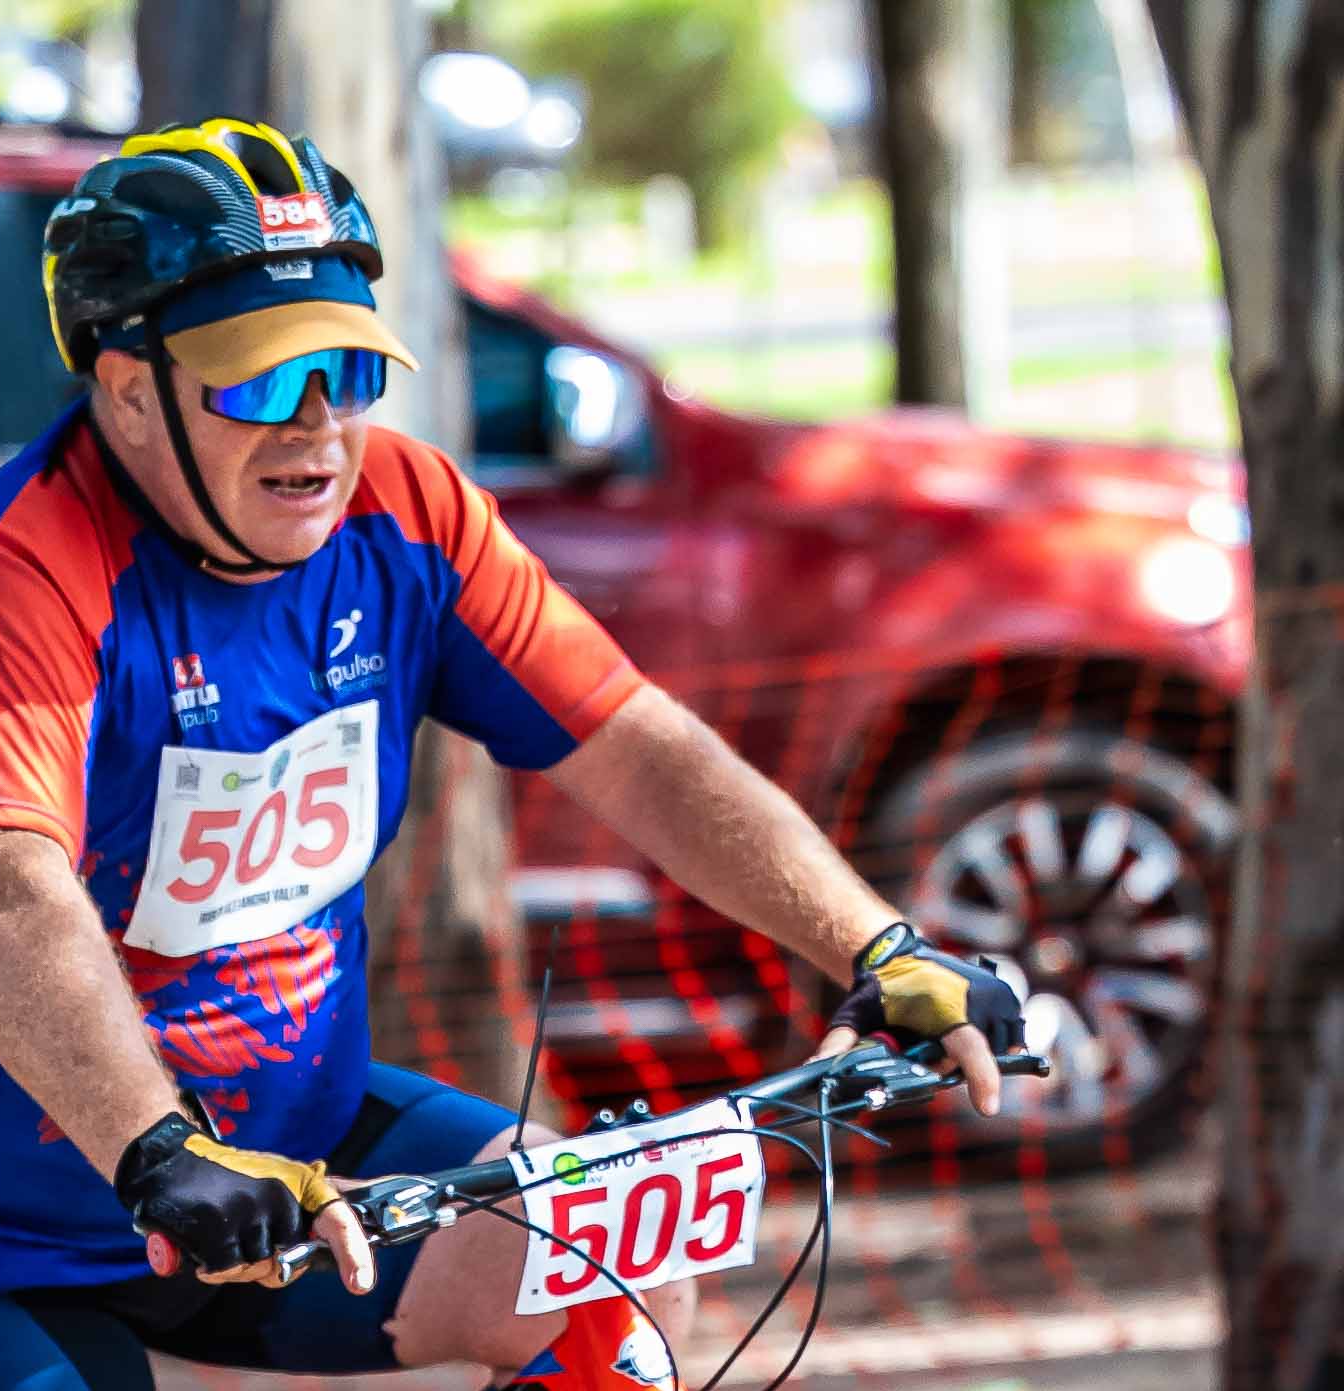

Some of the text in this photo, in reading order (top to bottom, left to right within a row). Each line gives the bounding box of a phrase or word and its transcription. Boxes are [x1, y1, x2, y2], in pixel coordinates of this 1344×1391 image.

[262, 199, 325, 226] 584
[308, 653, 384, 693] Ipulso
[166, 766, 350, 904] 505
[544, 1152, 746, 1297] 505
